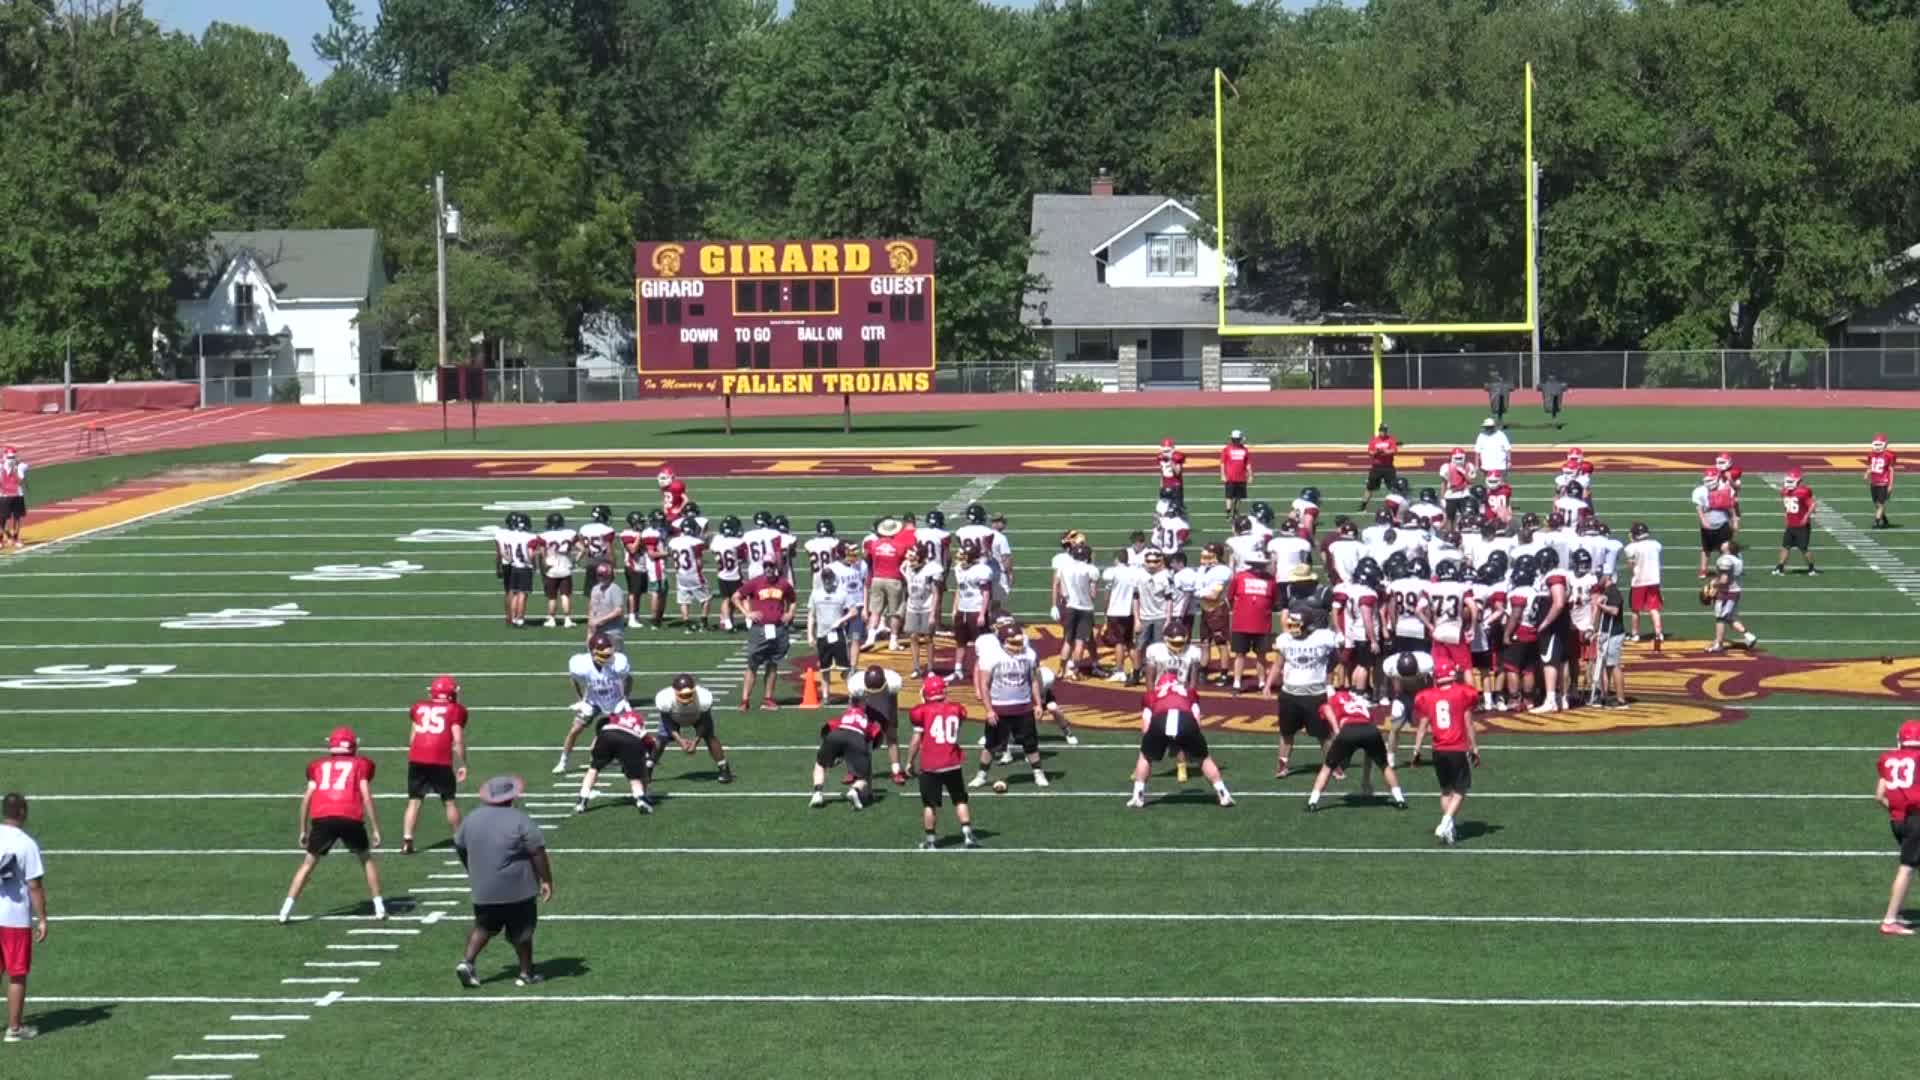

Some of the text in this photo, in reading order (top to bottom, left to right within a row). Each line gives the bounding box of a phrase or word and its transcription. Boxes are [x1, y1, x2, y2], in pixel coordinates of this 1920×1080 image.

[700, 243, 871, 274] GIRARD
[641, 279, 704, 298] GIRARD
[870, 276, 924, 295] GUEST
[680, 328, 718, 342] DOWN
[734, 327, 771, 342] TO GO
[797, 326, 842, 341] BALL ON
[861, 325, 886, 341] QTR
[722, 374, 813, 394] FALLEN
[822, 372, 930, 393] TROJANS
[415, 705, 447, 735] 35
[929, 715, 960, 745] 40
[319, 761, 353, 791] 17
[1884, 757, 1915, 790] 33
